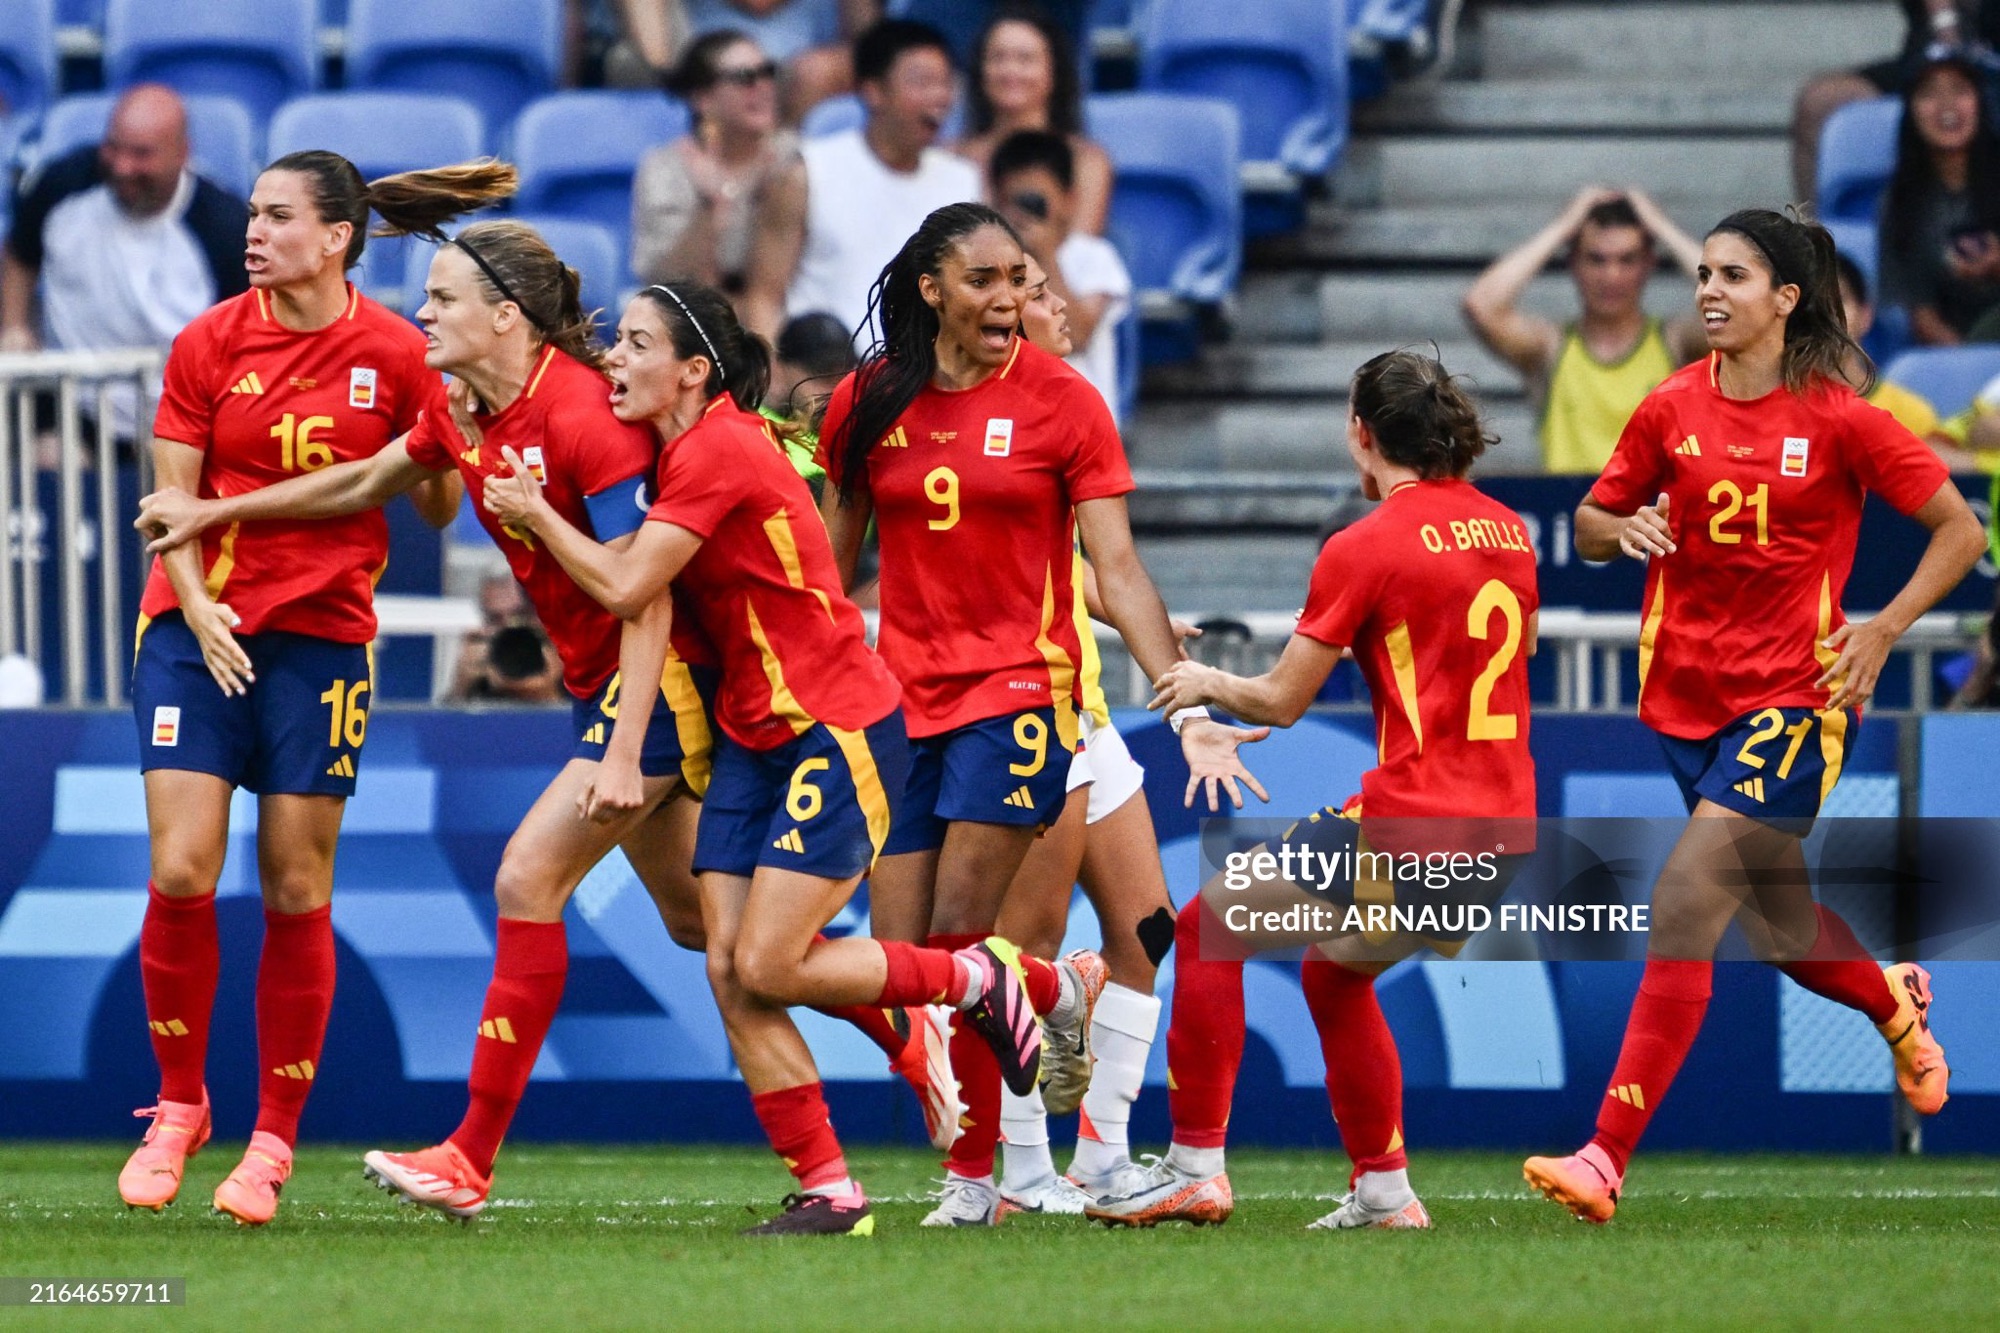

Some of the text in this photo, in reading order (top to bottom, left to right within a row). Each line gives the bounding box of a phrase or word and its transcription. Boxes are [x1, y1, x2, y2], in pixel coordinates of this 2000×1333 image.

[270, 412, 334, 473] 16
[924, 466, 961, 531] 9
[1708, 479, 1769, 546] 21
[1420, 523, 1452, 554] O.
[1449, 517, 1530, 553] BATLLE
[1467, 578, 1523, 742] 2
[320, 679, 369, 749] 16
[1009, 712, 1049, 778] 9
[1736, 707, 1814, 780] 21
[785, 757, 830, 822] 6
